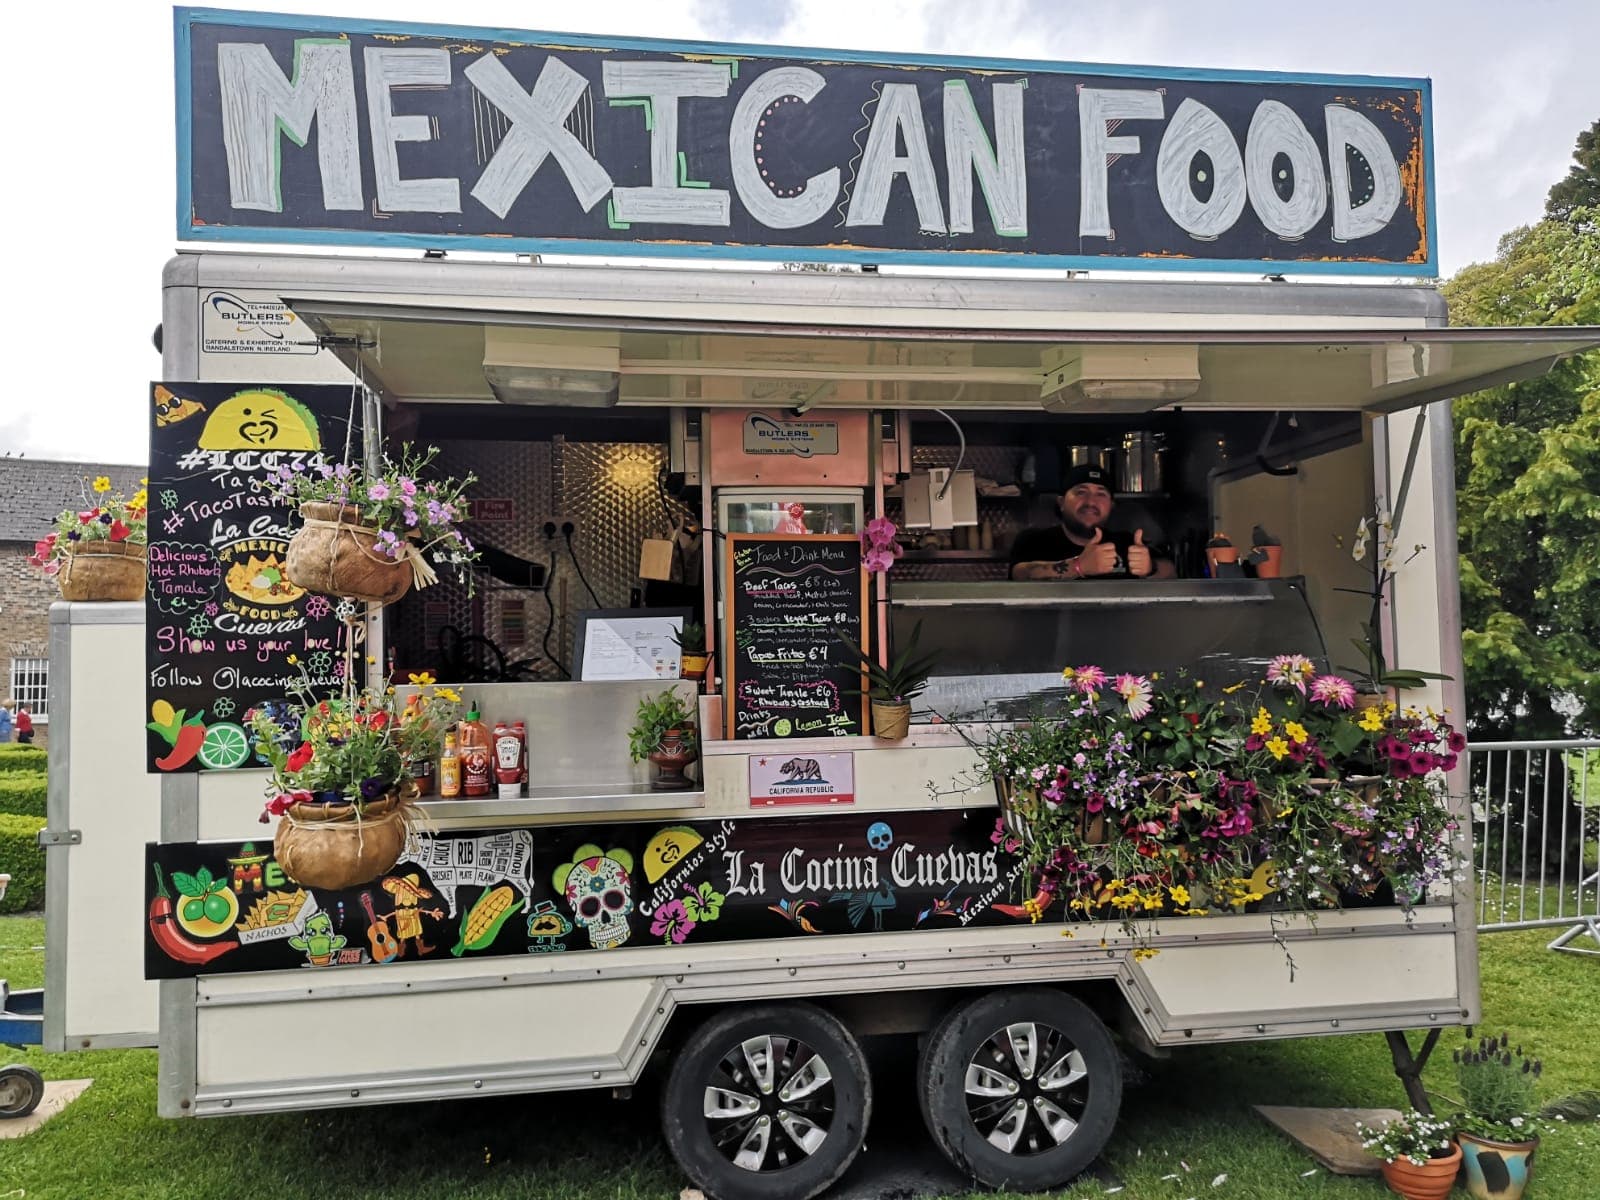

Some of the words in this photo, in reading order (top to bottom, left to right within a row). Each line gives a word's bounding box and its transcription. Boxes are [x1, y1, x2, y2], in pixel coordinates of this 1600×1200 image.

[217, 39, 1029, 238] MEXICAN
[1078, 87, 1403, 241] FOOD
[221, 312, 284, 320] BUTLERS
[210, 517, 242, 546] La
[149, 545, 208, 563] Delicious
[233, 539, 289, 554] MEXIC
[790, 545, 820, 564] Drink
[821, 547, 846, 560] Menu
[151, 563, 175, 577] Hot
[178, 563, 221, 577] Rhubarb
[158, 579, 208, 595] Tamale
[743, 579, 768, 591] Beef
[770, 578, 797, 590] Tacos
[239, 605, 282, 621] FOOD
[213, 612, 308, 635] Cuevas
[156, 625, 216, 655] Show
[226, 638, 249, 651] us
[256, 638, 294, 663] your
[808, 645, 828, 661] €4
[150, 662, 203, 688] Follow
[744, 685, 776, 696] Sweet
[738, 709, 771, 722] Drinks
[795, 718, 822, 731] Lemon
[827, 726, 848, 737] Tea
[769, 787, 804, 795] CALIFORNIA
[805, 785, 834, 794] REPUBLIC
[432, 841, 451, 866] CHUCK
[457, 841, 474, 865] RIB
[511, 842, 525, 875] ROUND
[431, 870, 453, 881] BRISKET
[459, 870, 473, 880] PLATE
[478, 871, 496, 882] FLANK
[722, 849, 767, 897] La
[780, 843, 879, 894] Cocina
[890, 842, 998, 888] Cuevas
[639, 852, 704, 917] Californios
[958, 881, 1005, 927] Mexican
[245, 926, 288, 941] NACHOS
